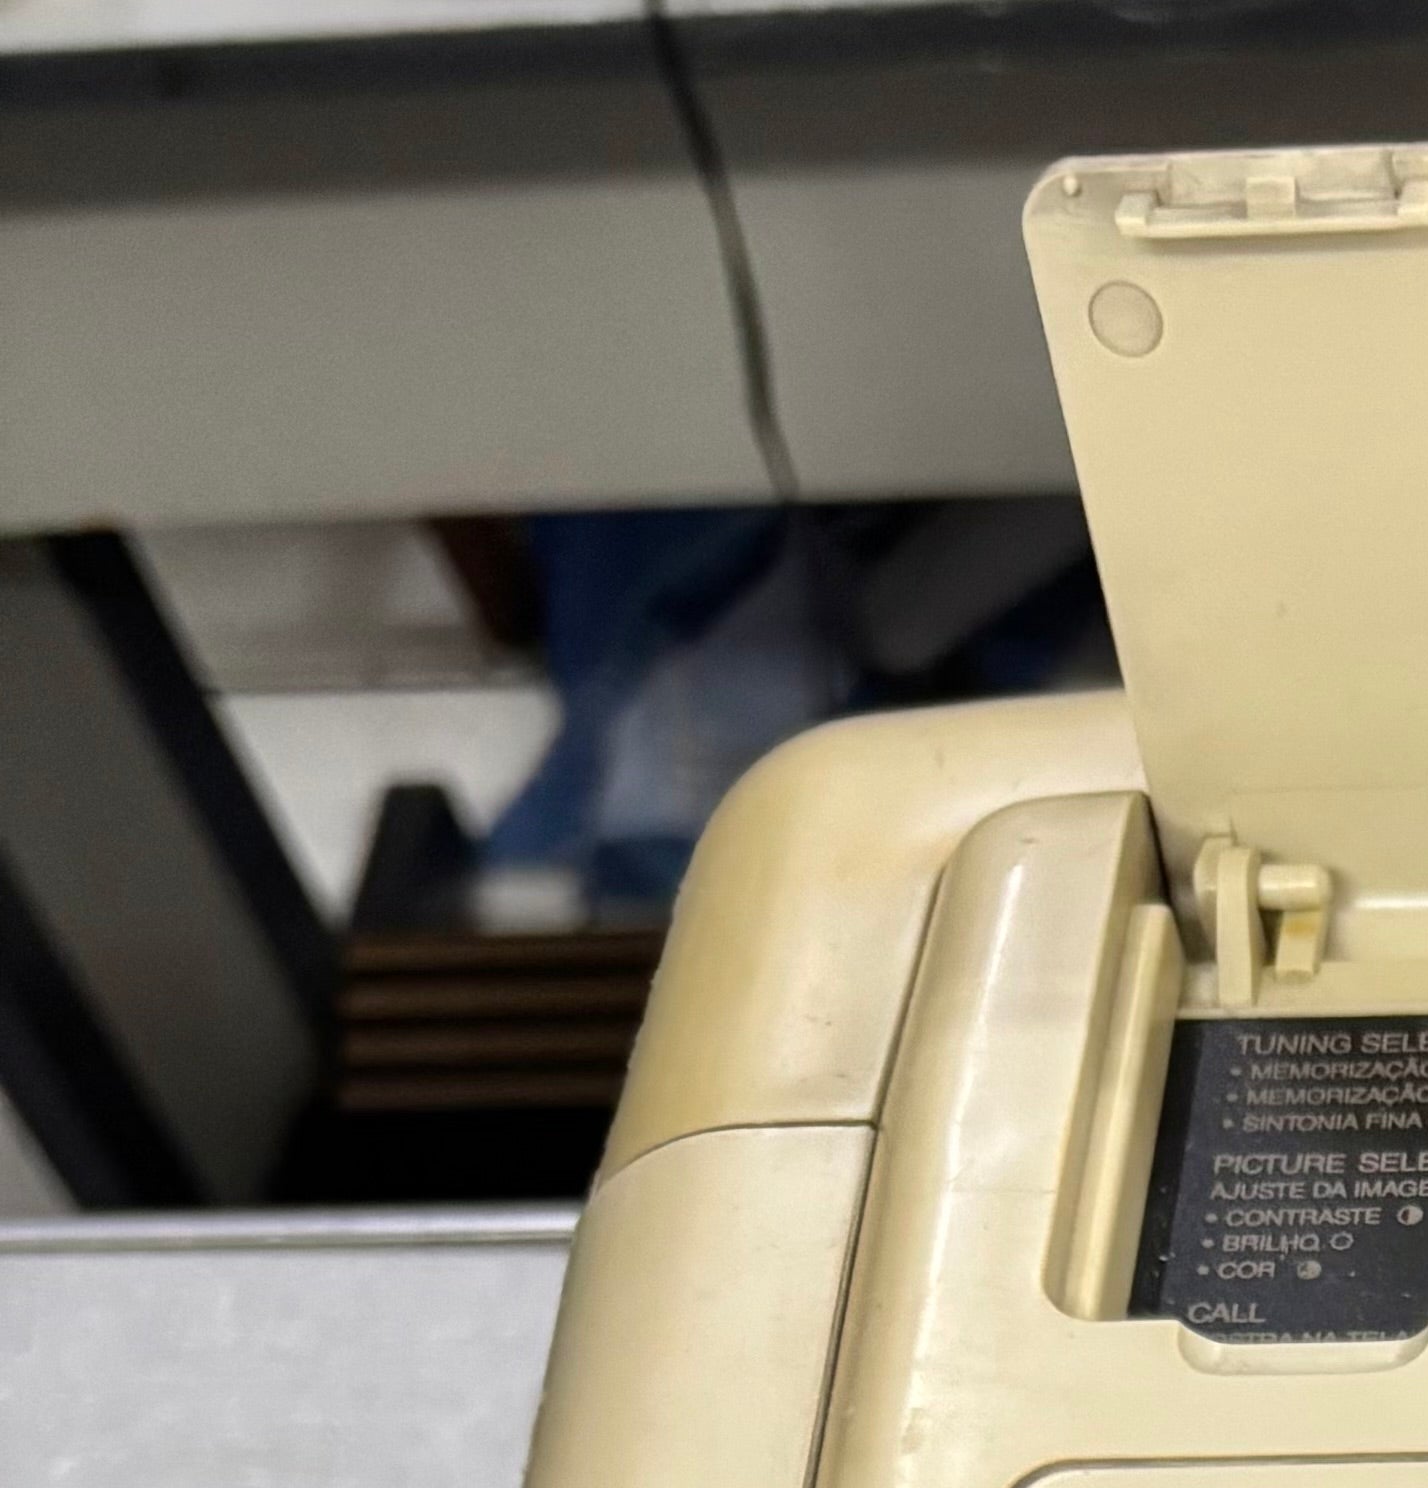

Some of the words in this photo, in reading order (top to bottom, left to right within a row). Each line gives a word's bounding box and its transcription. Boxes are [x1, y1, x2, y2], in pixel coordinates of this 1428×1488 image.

[1237, 1032, 1351, 1055] TUNING
[1242, 1113, 1359, 1133] SINTONIA
[1365, 1111, 1423, 1130] FINA
[1212, 1153, 1347, 1175] PICTURE
[1210, 1181, 1305, 1200] AJUSTE
[1312, 1180, 1347, 1199] DA
[1225, 1207, 1382, 1227] CONTRASTE
[1221, 1233, 1321, 1253] BRILHO
[1216, 1261, 1276, 1280] COR
[1187, 1301, 1267, 1324] CALL
